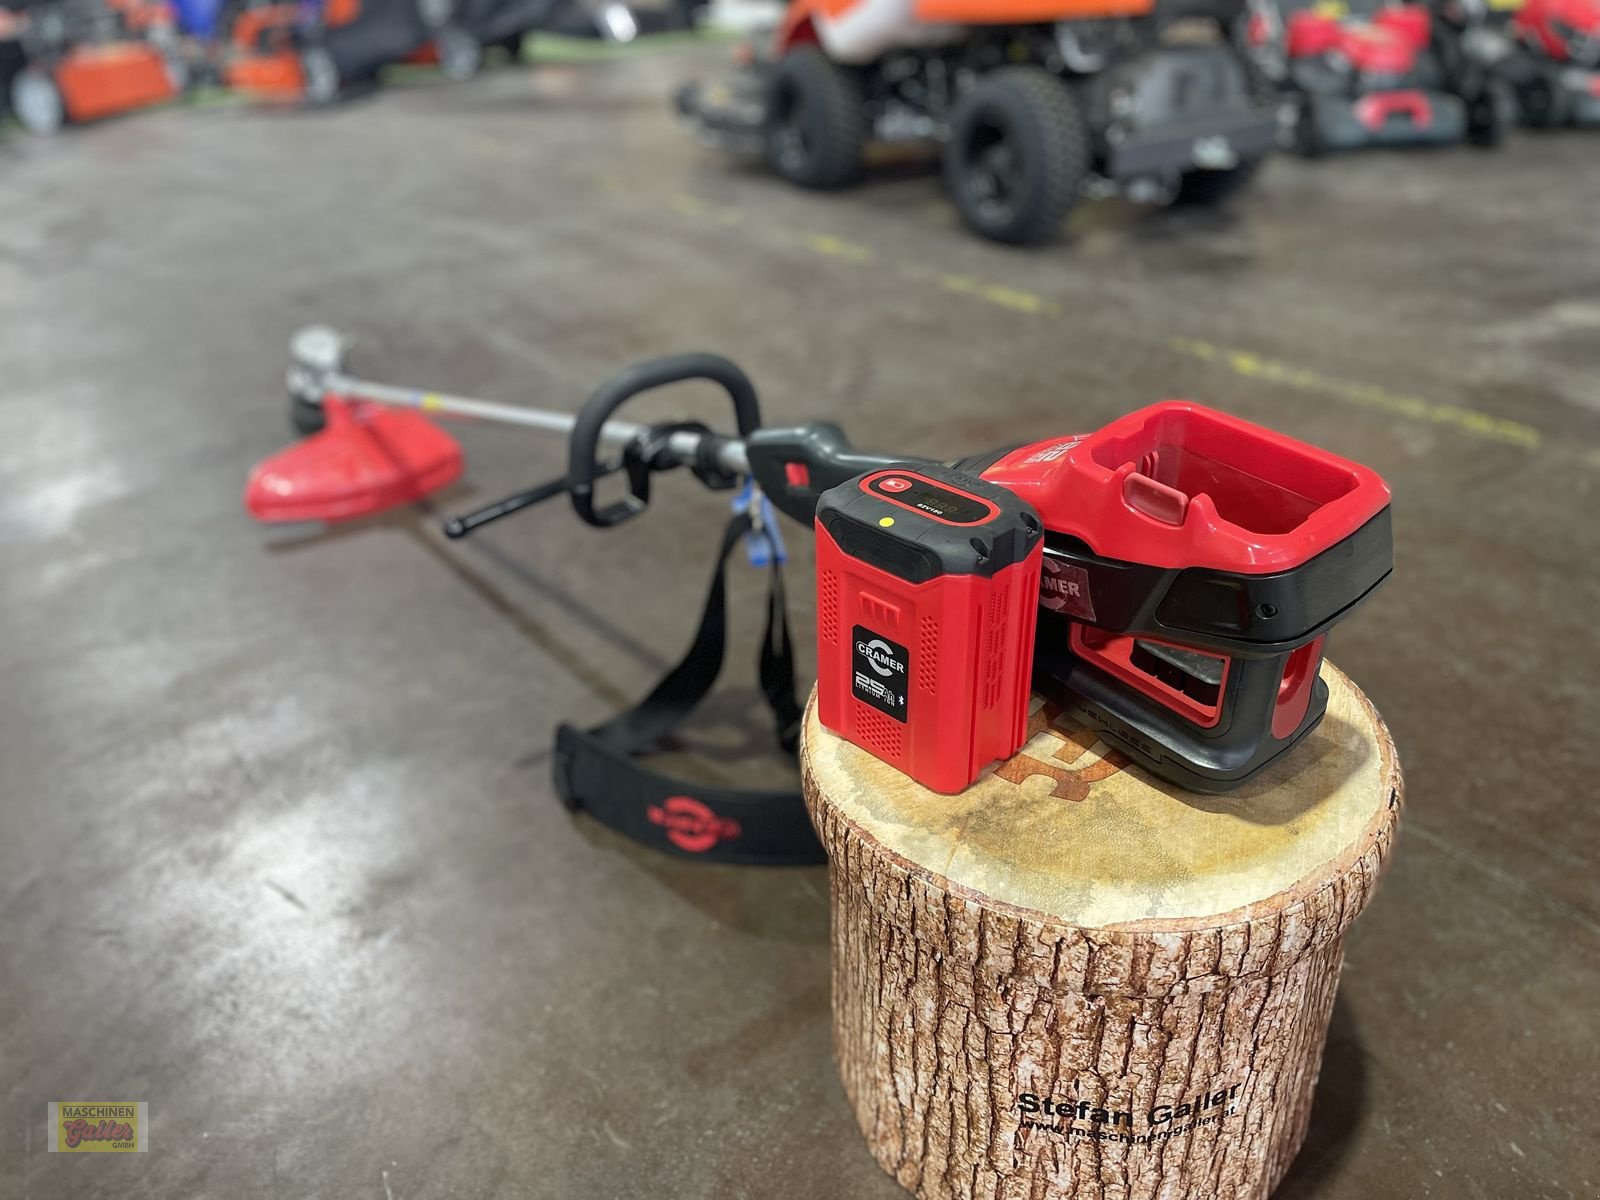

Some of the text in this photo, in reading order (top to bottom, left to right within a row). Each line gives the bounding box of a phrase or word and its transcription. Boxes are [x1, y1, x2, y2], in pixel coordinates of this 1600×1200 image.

[1041, 576, 1081, 598] MER
[858, 643, 904, 674] CRAMER
[856, 682, 881, 700] LITHIUM
[1018, 1093, 1134, 1127] Stefan
